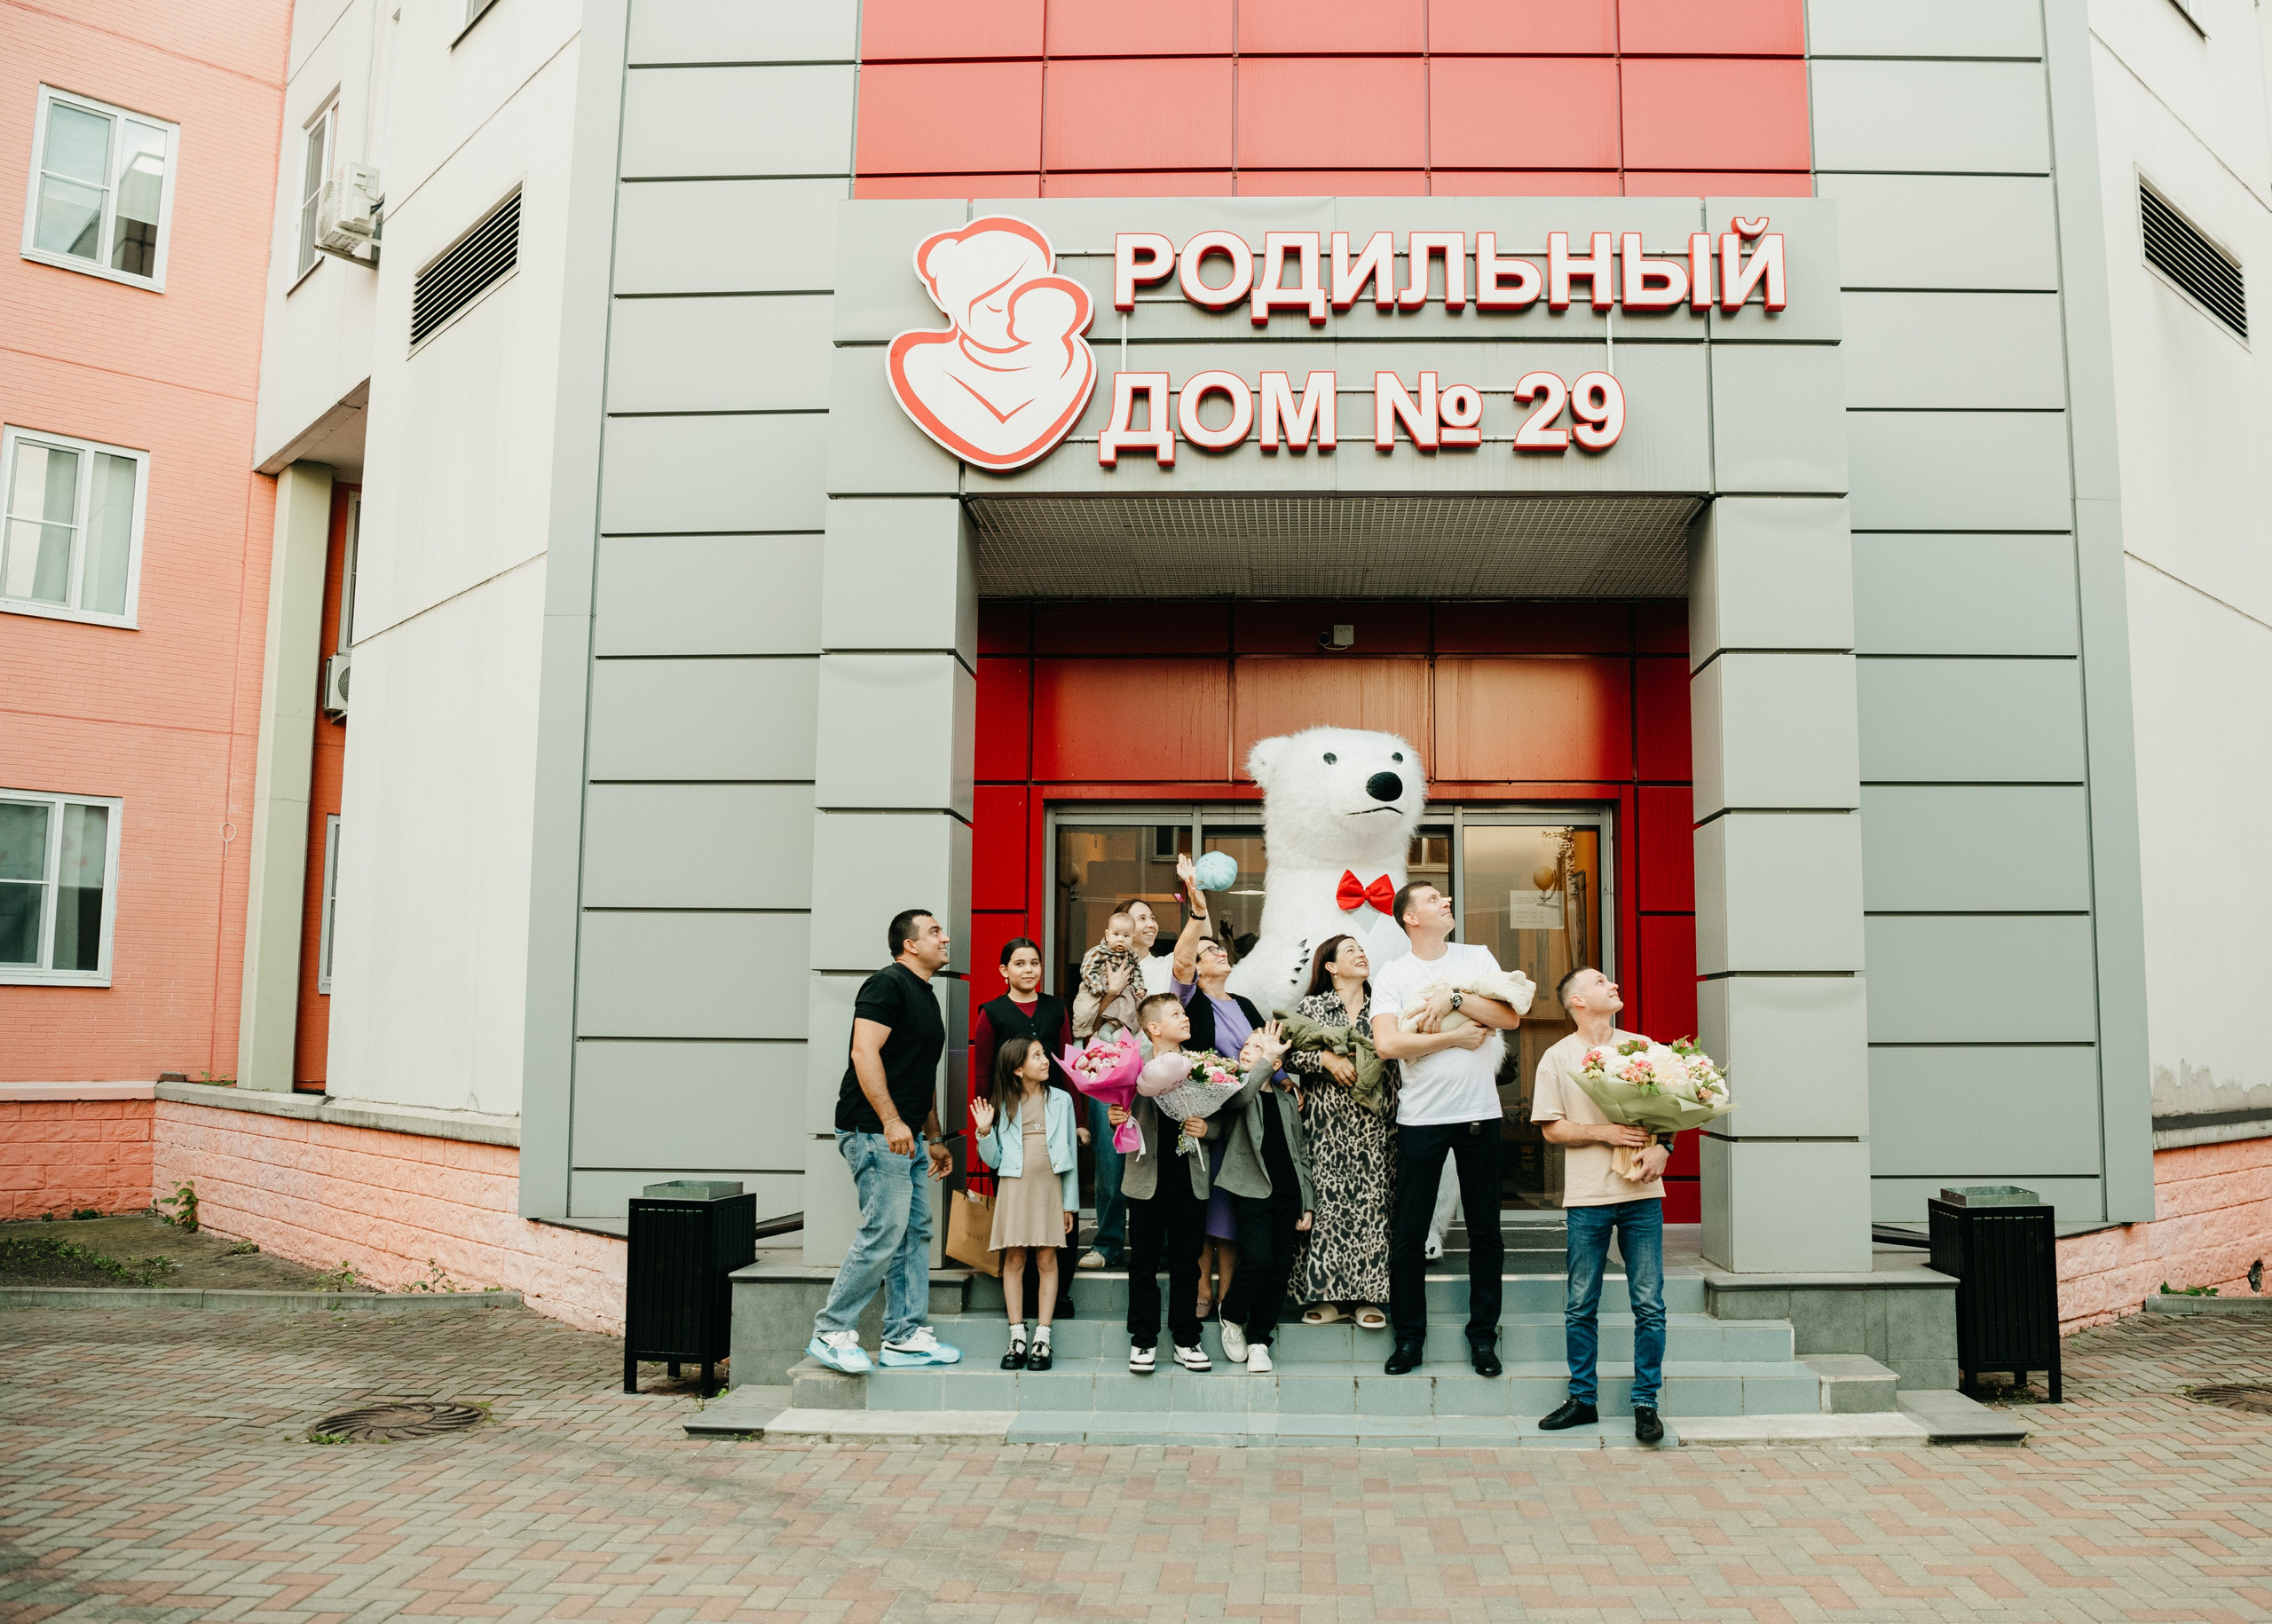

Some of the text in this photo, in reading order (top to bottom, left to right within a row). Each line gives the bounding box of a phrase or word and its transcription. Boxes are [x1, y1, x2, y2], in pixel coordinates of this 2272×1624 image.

[1114, 217, 1788, 326] РОДИЛЬНЫЙ
[1099, 370, 1626, 467] ДОМ № 29
